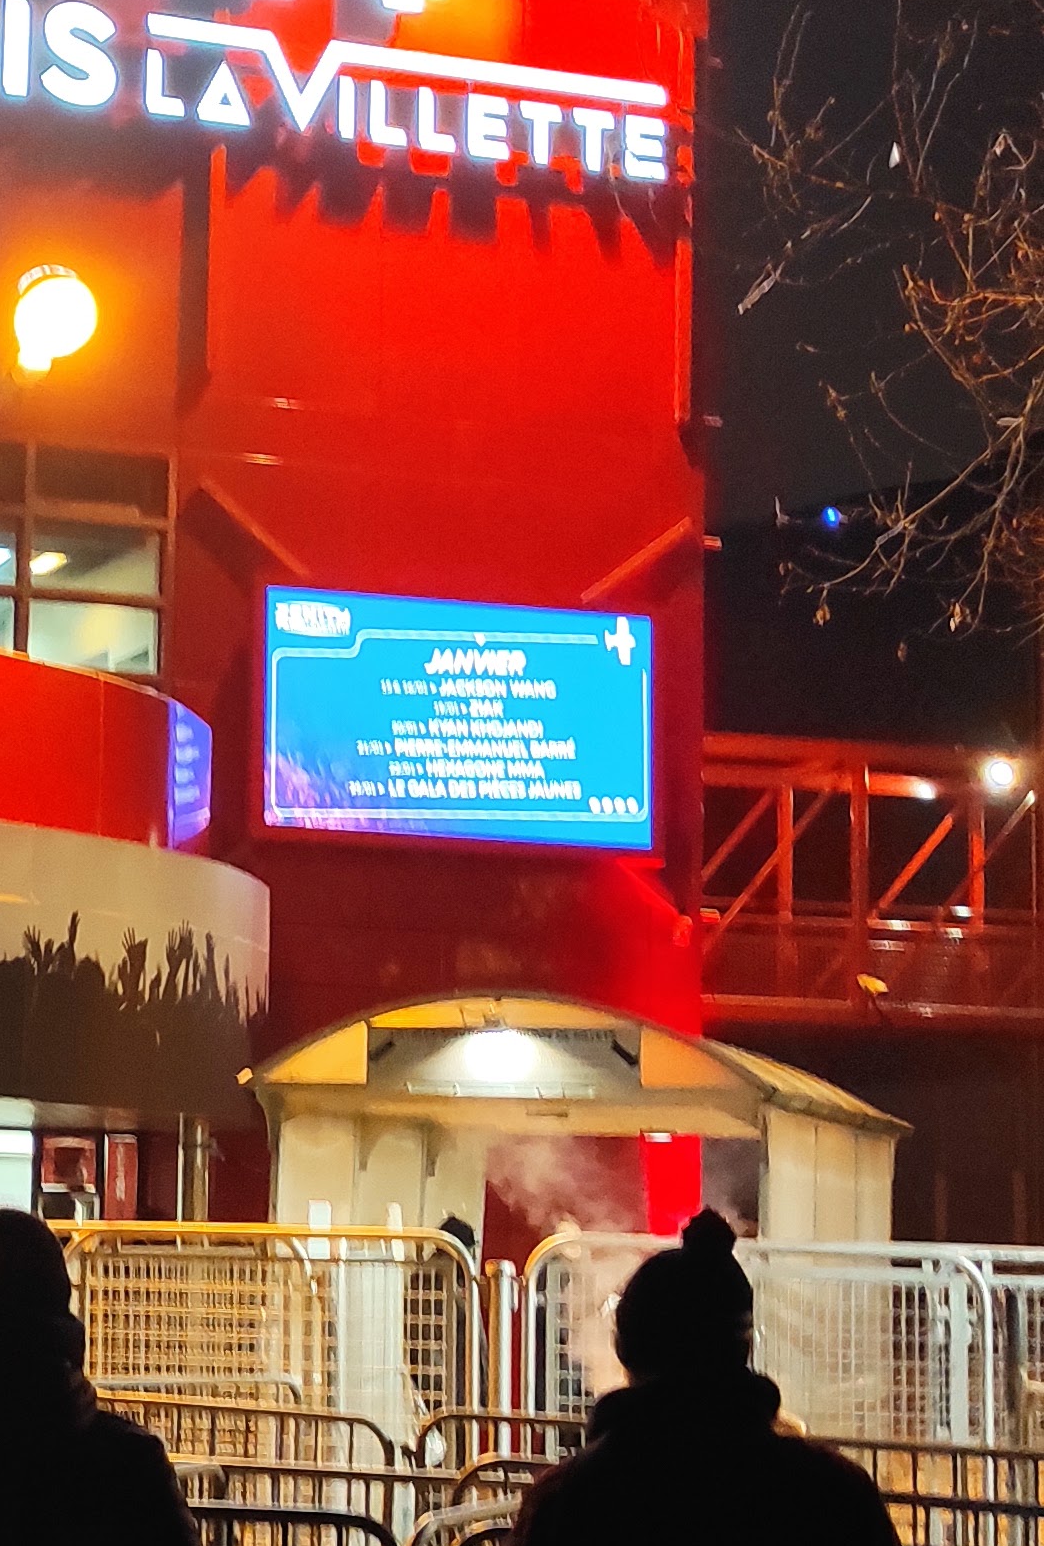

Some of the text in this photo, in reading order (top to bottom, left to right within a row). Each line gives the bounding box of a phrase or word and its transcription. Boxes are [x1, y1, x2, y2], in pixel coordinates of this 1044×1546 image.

[144, 47, 251, 127] LA
[256, 23, 667, 181] VILLETTE
[424, 648, 526, 676] JANVIER
[439, 679, 507, 698] JACKSON
[509, 680, 556, 699] WANG
[428, 718, 468, 737] KYAN
[470, 719, 543, 738] KHOJANDI
[394, 739, 528, 758] PIERRE-EMMANUEL
[426, 758, 505, 778] HEXAGONE
[507, 760, 544, 779] MMA
[388, 779, 406, 798] LE
[407, 779, 447, 798] GALA
[448, 779, 477, 798] DES
[527, 780, 582, 800] JAUNES
